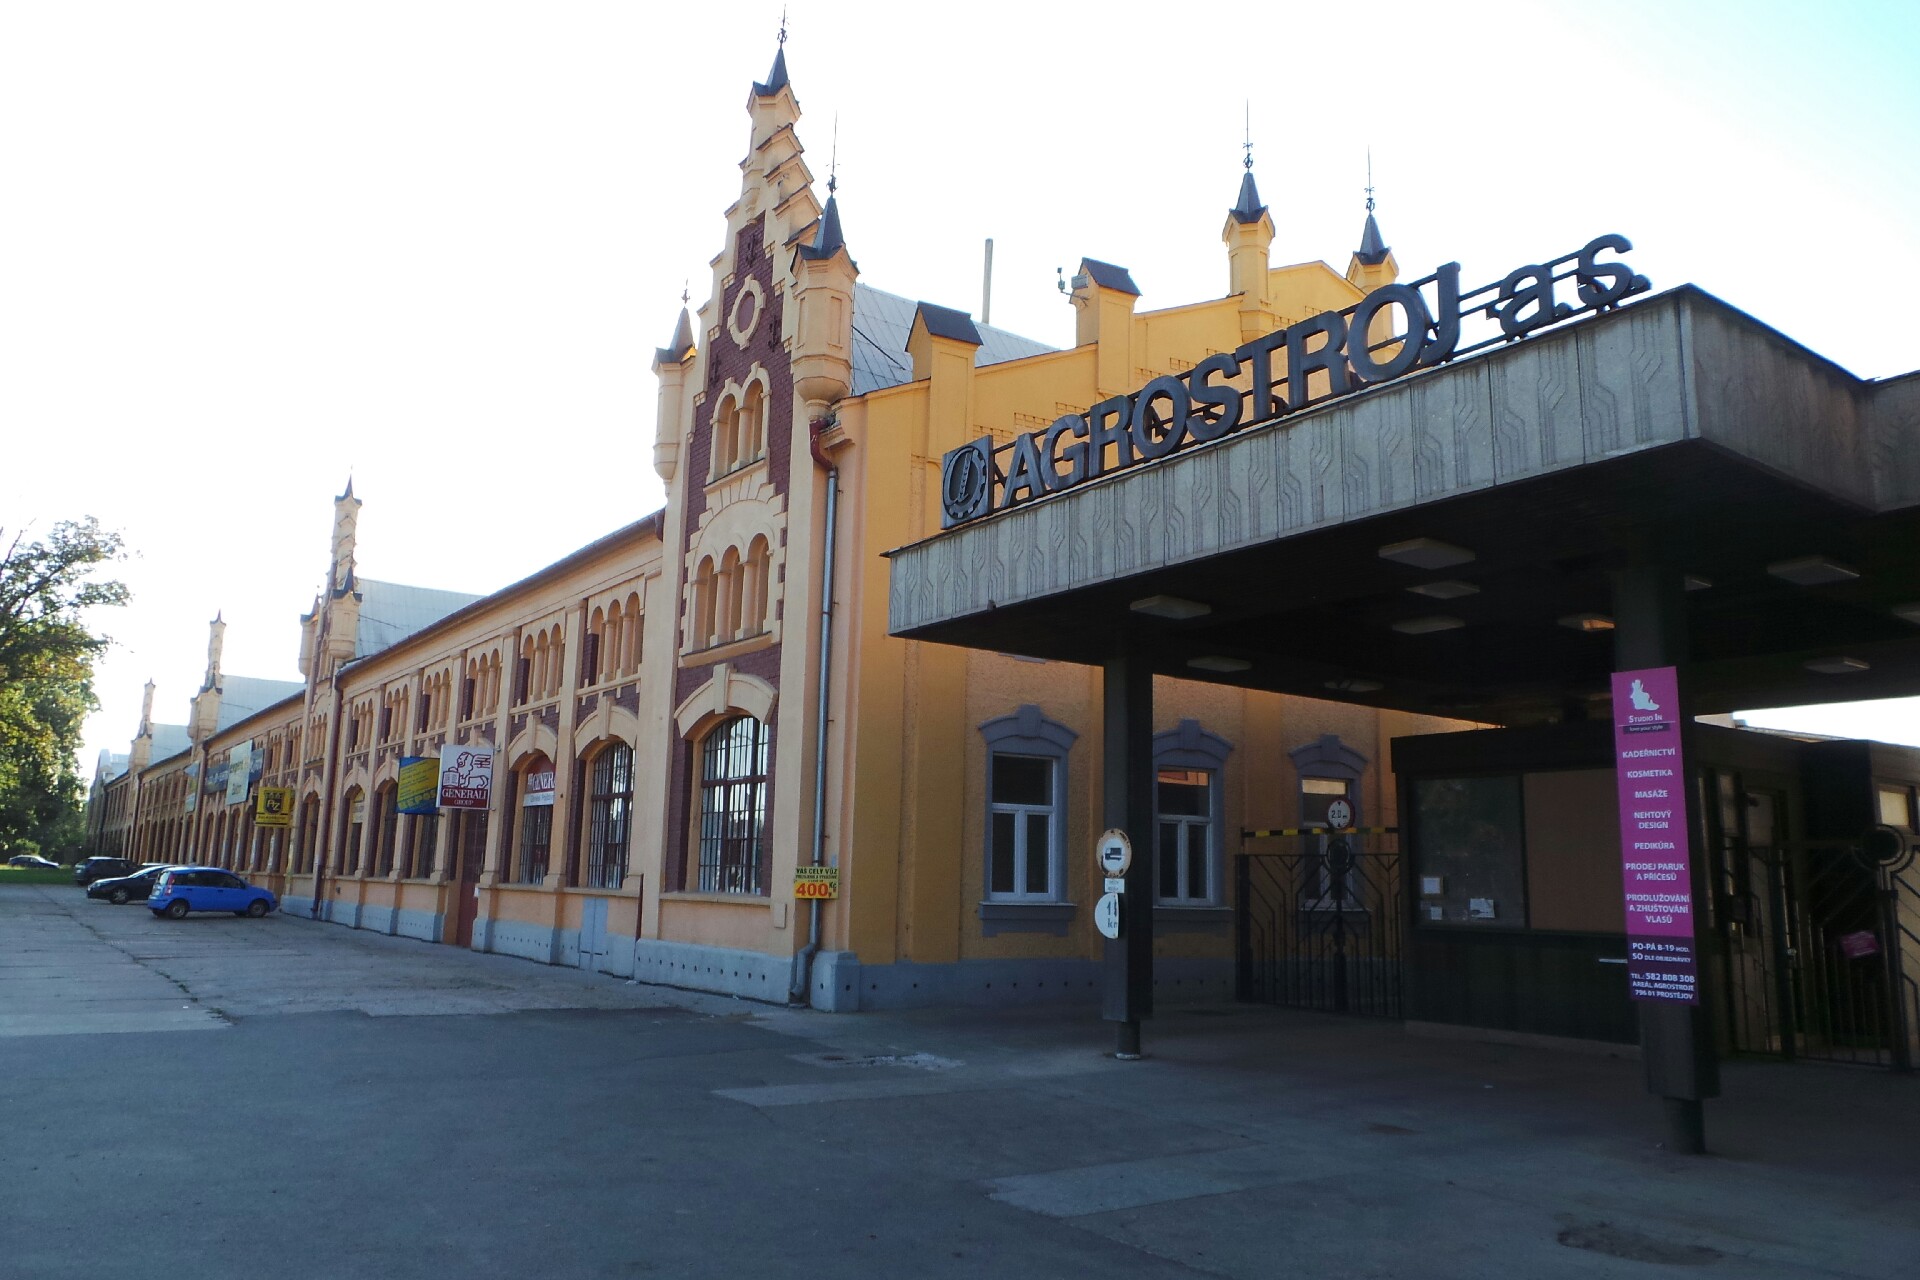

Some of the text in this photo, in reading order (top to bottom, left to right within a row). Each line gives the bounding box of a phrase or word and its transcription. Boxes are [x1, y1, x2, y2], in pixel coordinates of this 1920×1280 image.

[1002, 262, 1460, 505] AGROSTROJ
[1622, 747, 1675, 758] KADEŘNICTVÍ
[1627, 769, 1673, 778] KOSMETIKA
[532, 772, 556, 791] GENER
[442, 787, 487, 800] GENERALI
[1634, 789, 1668, 799] MASÁŽE
[1634, 809, 1671, 819] NEHTOVÝ
[1638, 821, 1668, 829] DESIGN
[1625, 863, 1685, 871] PRODEJ PARUK
[1636, 872, 1643, 880] A
[1645, 914, 1673, 924] VLASŮ
[1632, 942, 1656, 951] PO-PÁ
[1657, 943, 1675, 952] 8-19
[1632, 952, 1643, 960] SO
[1645, 972, 1661, 981] 582
[1653, 981, 1695, 992] AGROSTROJE
[1656, 990, 1694, 1000] PROSTĚJOV
